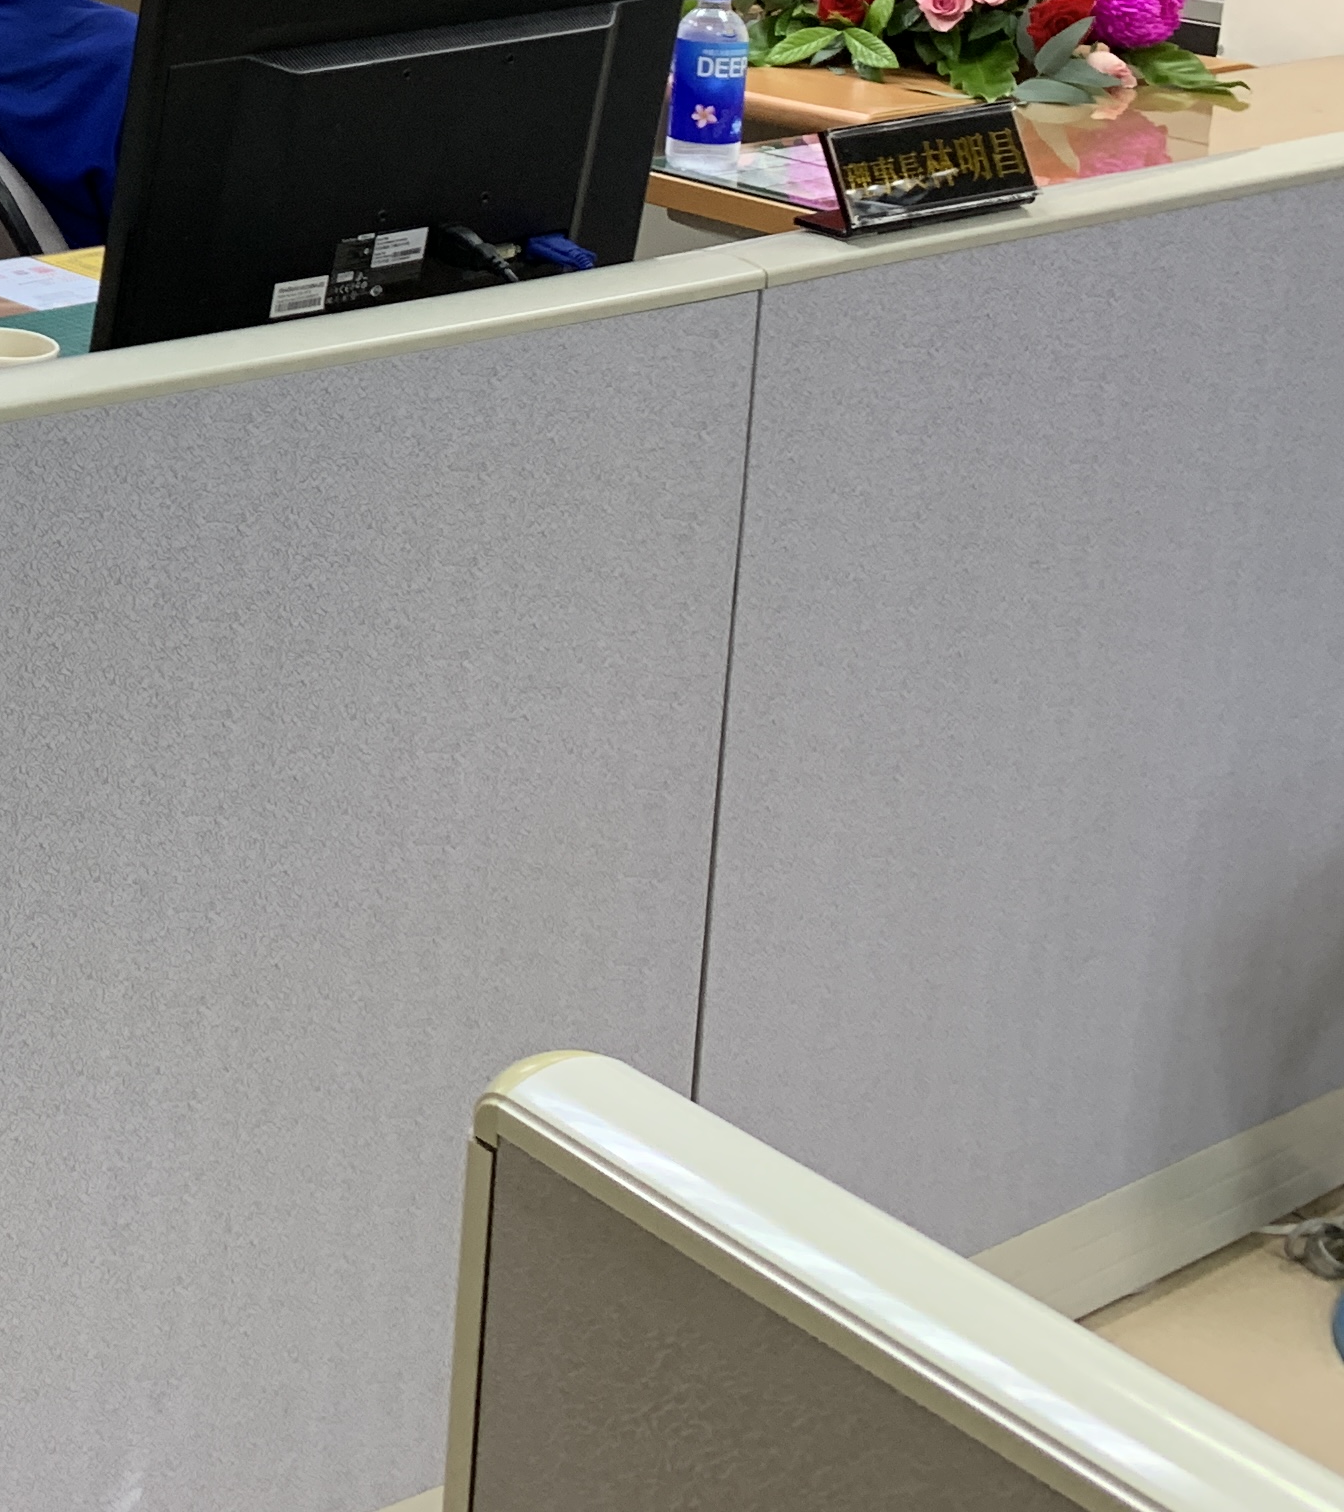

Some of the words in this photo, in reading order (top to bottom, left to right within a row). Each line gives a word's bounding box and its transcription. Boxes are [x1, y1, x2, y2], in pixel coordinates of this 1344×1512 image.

[842, 127, 1026, 196] 理事長林明昌
